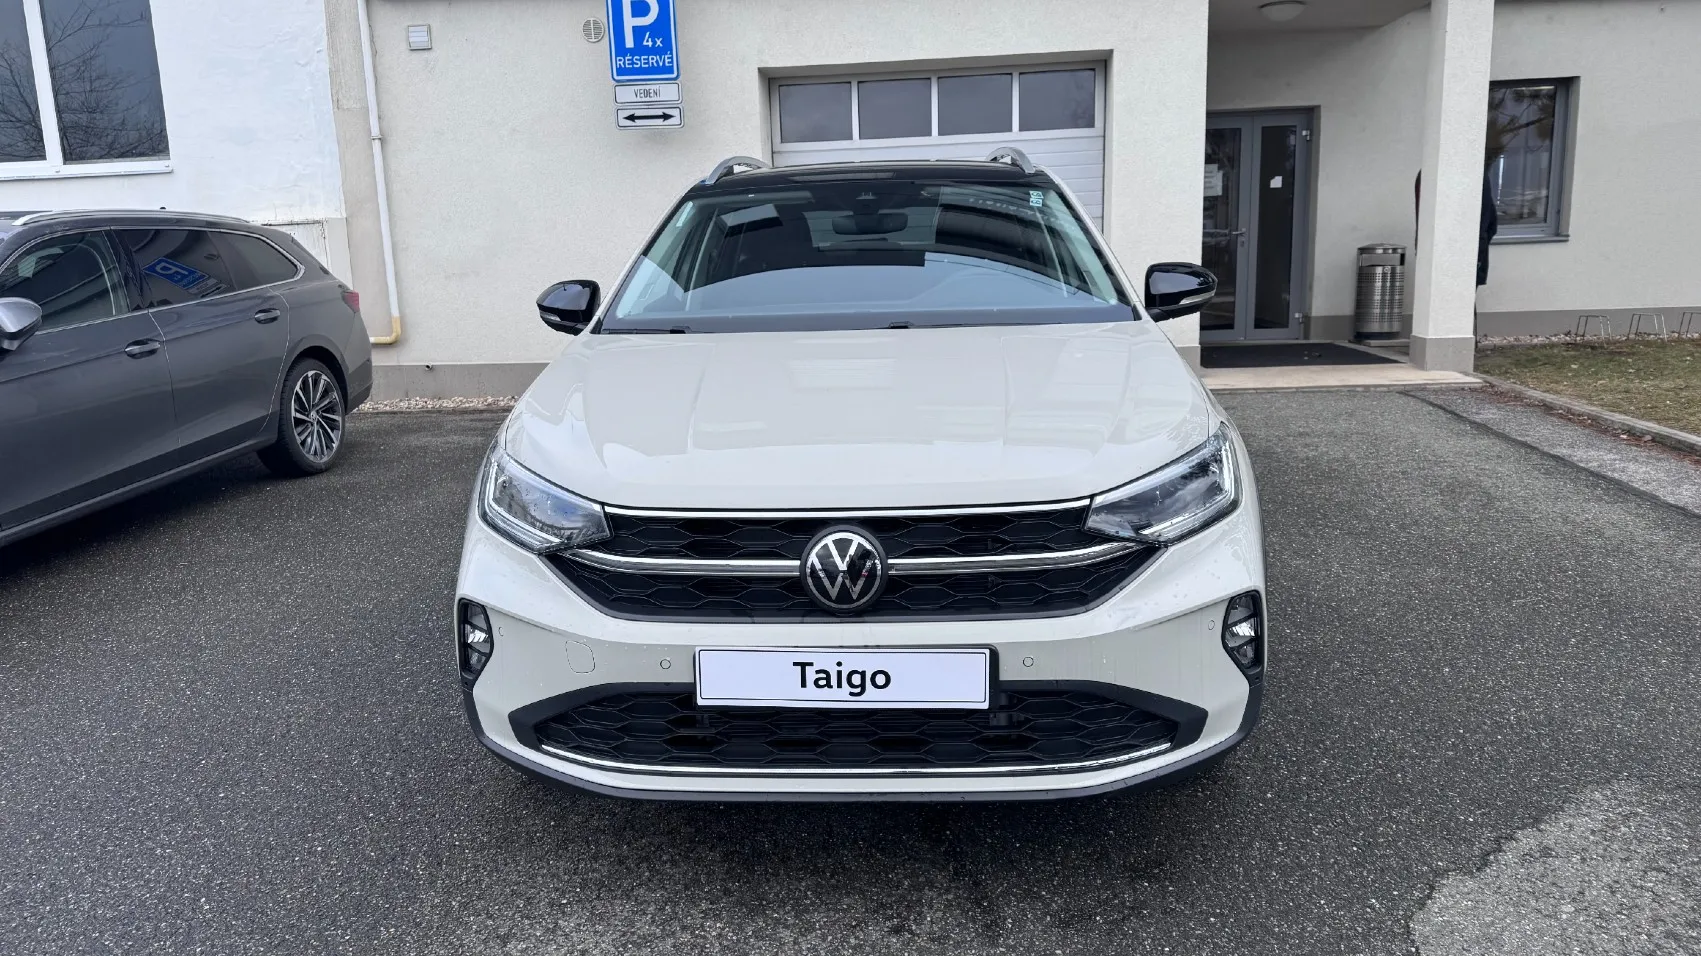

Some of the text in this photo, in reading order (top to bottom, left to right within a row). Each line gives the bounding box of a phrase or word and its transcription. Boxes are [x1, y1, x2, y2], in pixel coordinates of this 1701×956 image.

[622, 0, 659, 48] P
[616, 51, 673, 68] RÉSERVÉ
[792, 661, 892, 697] Taigo
